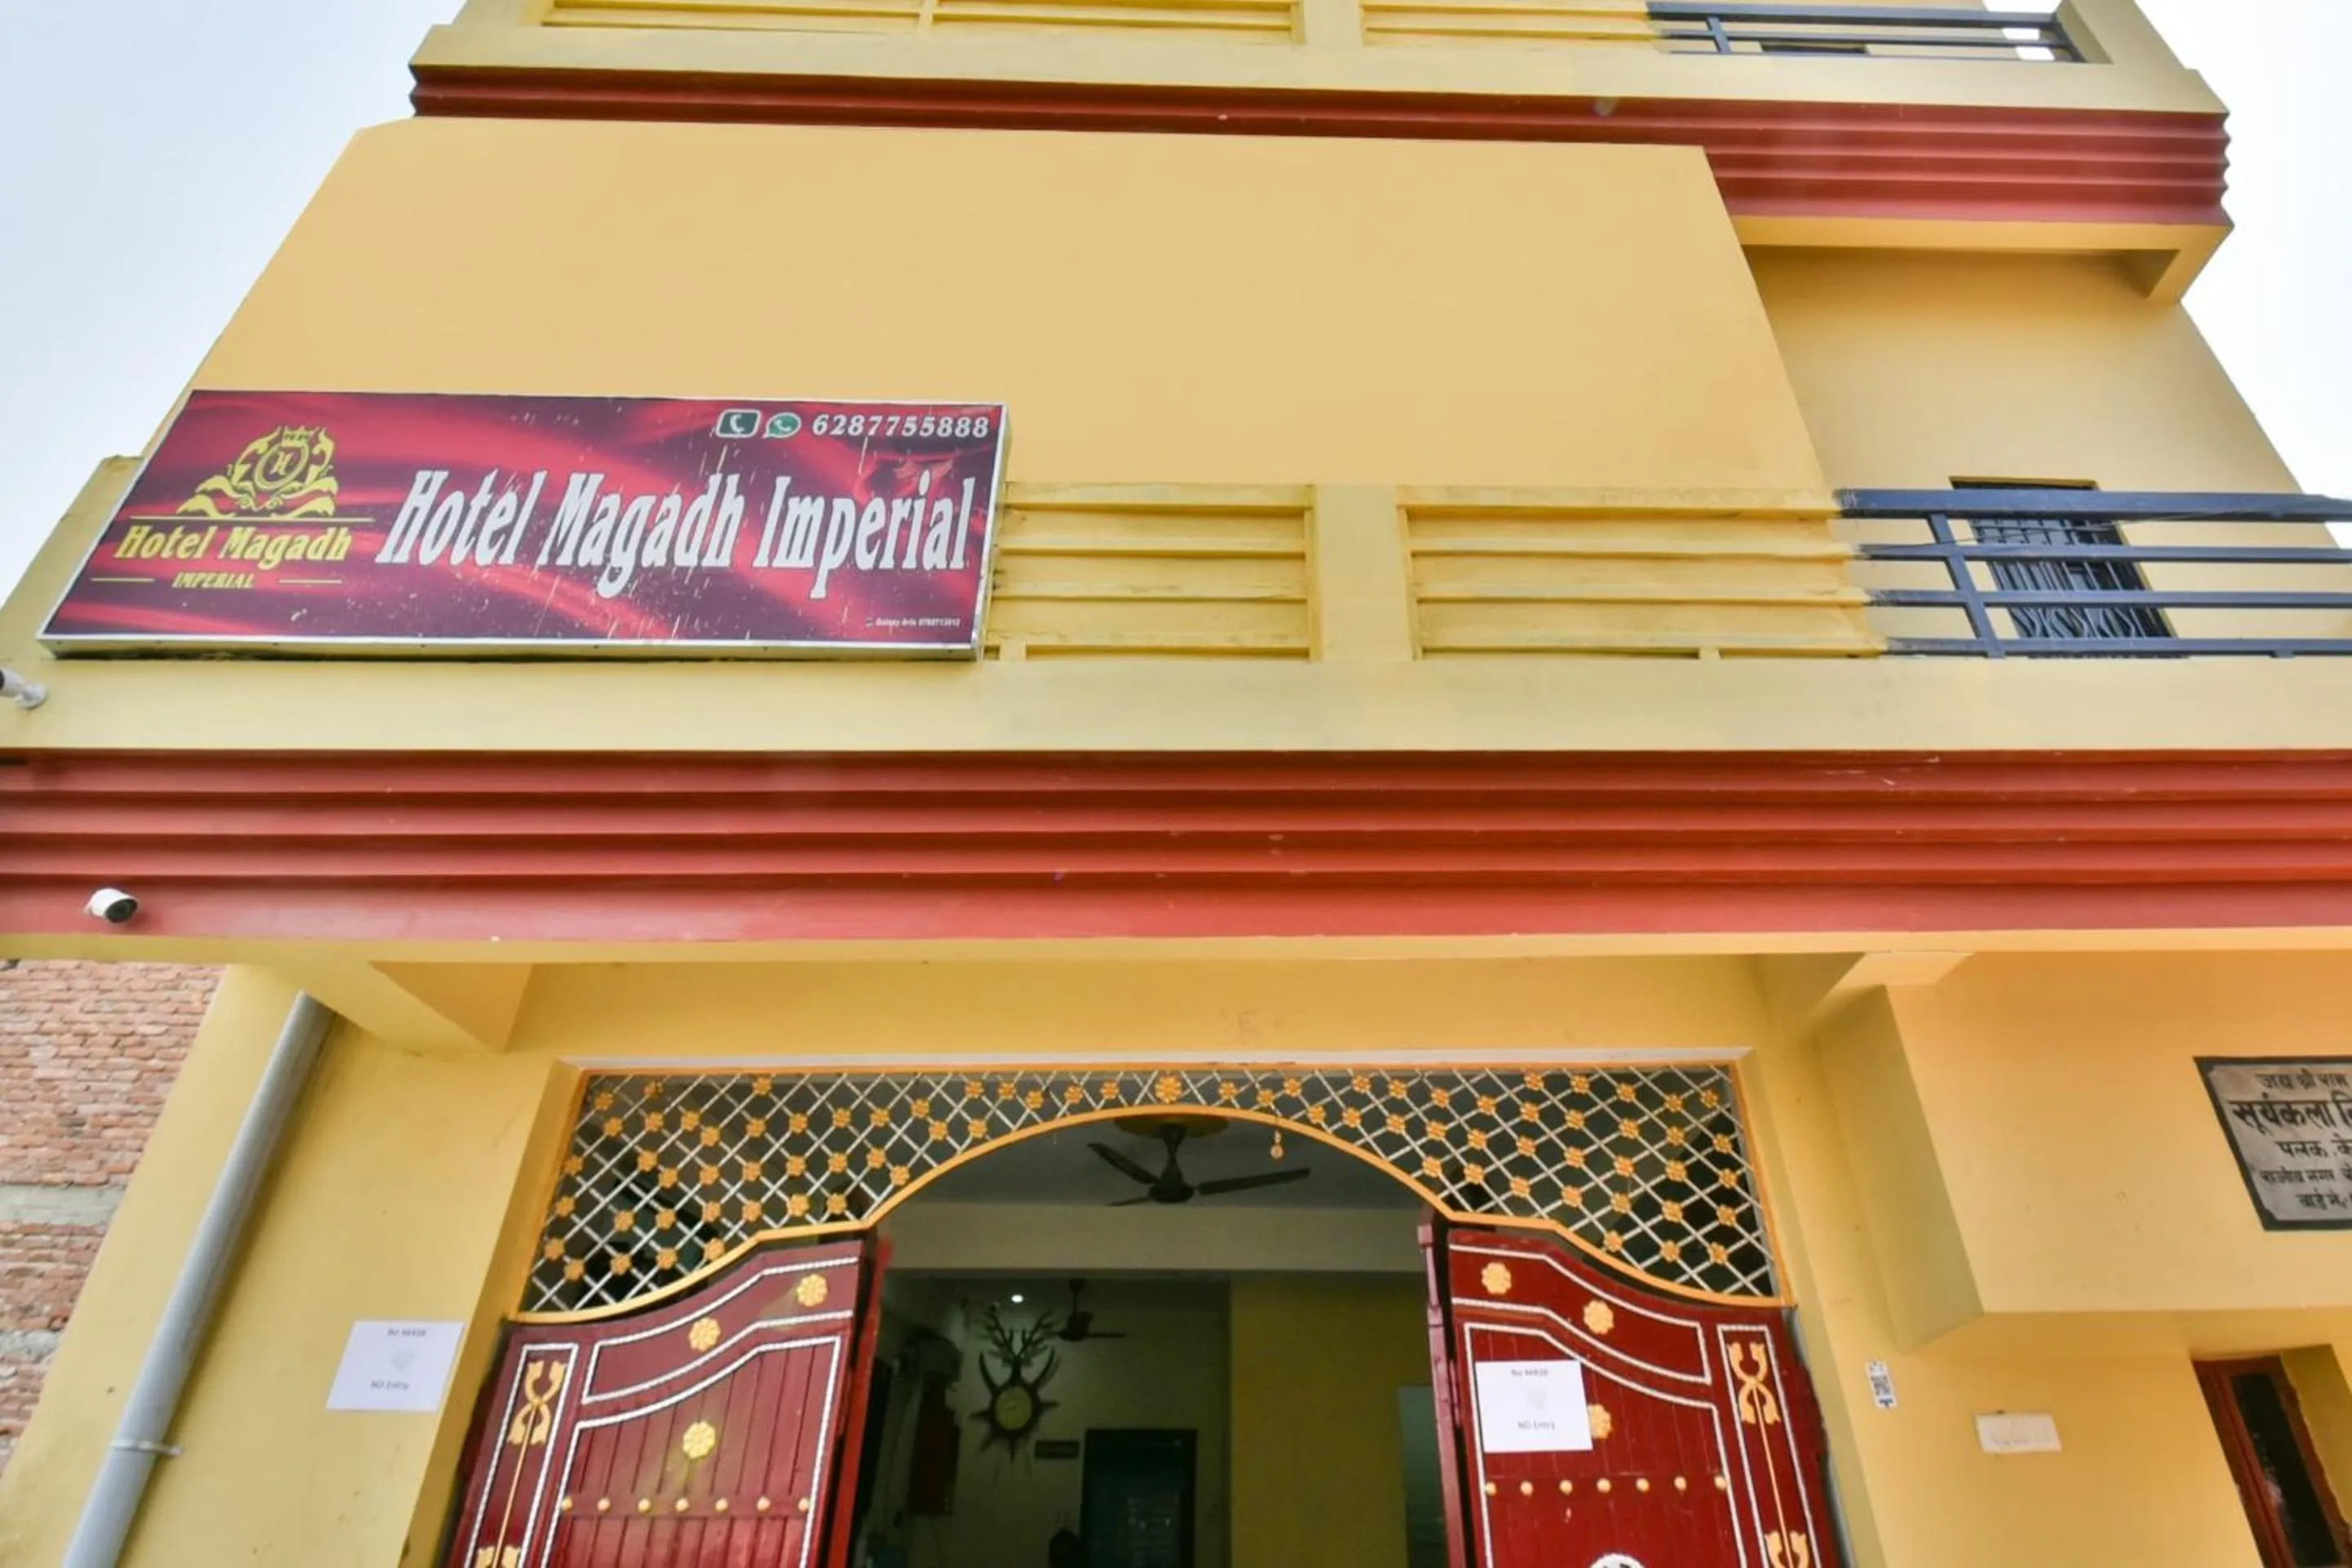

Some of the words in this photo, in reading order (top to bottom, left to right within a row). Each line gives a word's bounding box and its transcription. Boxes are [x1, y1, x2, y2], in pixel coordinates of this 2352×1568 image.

[813, 414, 989, 439] 6287755888
[114, 526, 213, 559] Hotel
[219, 527, 353, 569] Magadh
[375, 468, 548, 566] Hotel
[537, 471, 745, 599] Magadh
[753, 470, 975, 599] Imperial
[172, 572, 255, 589] IMPERIAL
